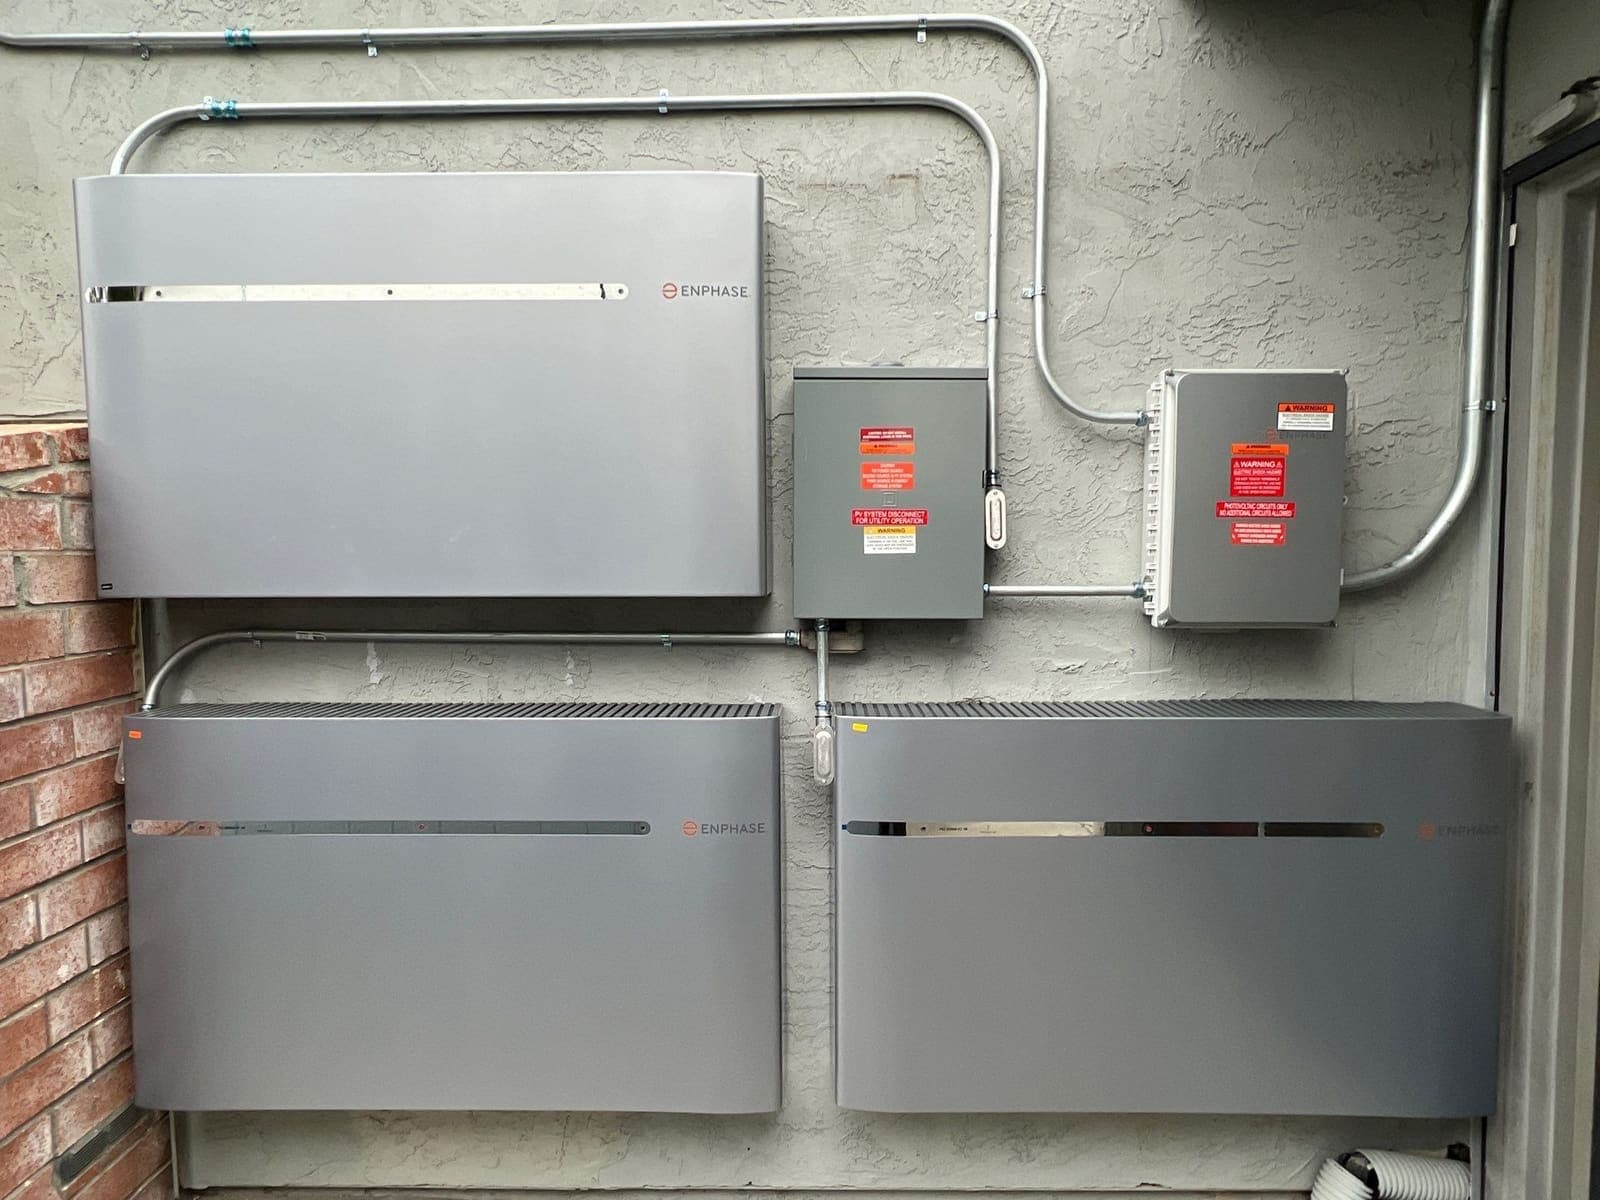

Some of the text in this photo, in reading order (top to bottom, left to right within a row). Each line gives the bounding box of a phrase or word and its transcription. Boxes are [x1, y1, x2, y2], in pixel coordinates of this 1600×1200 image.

[681, 285, 748, 298] ENPHASE
[1240, 460, 1276, 468] WARNING
[701, 822, 766, 834] ENPHASE
